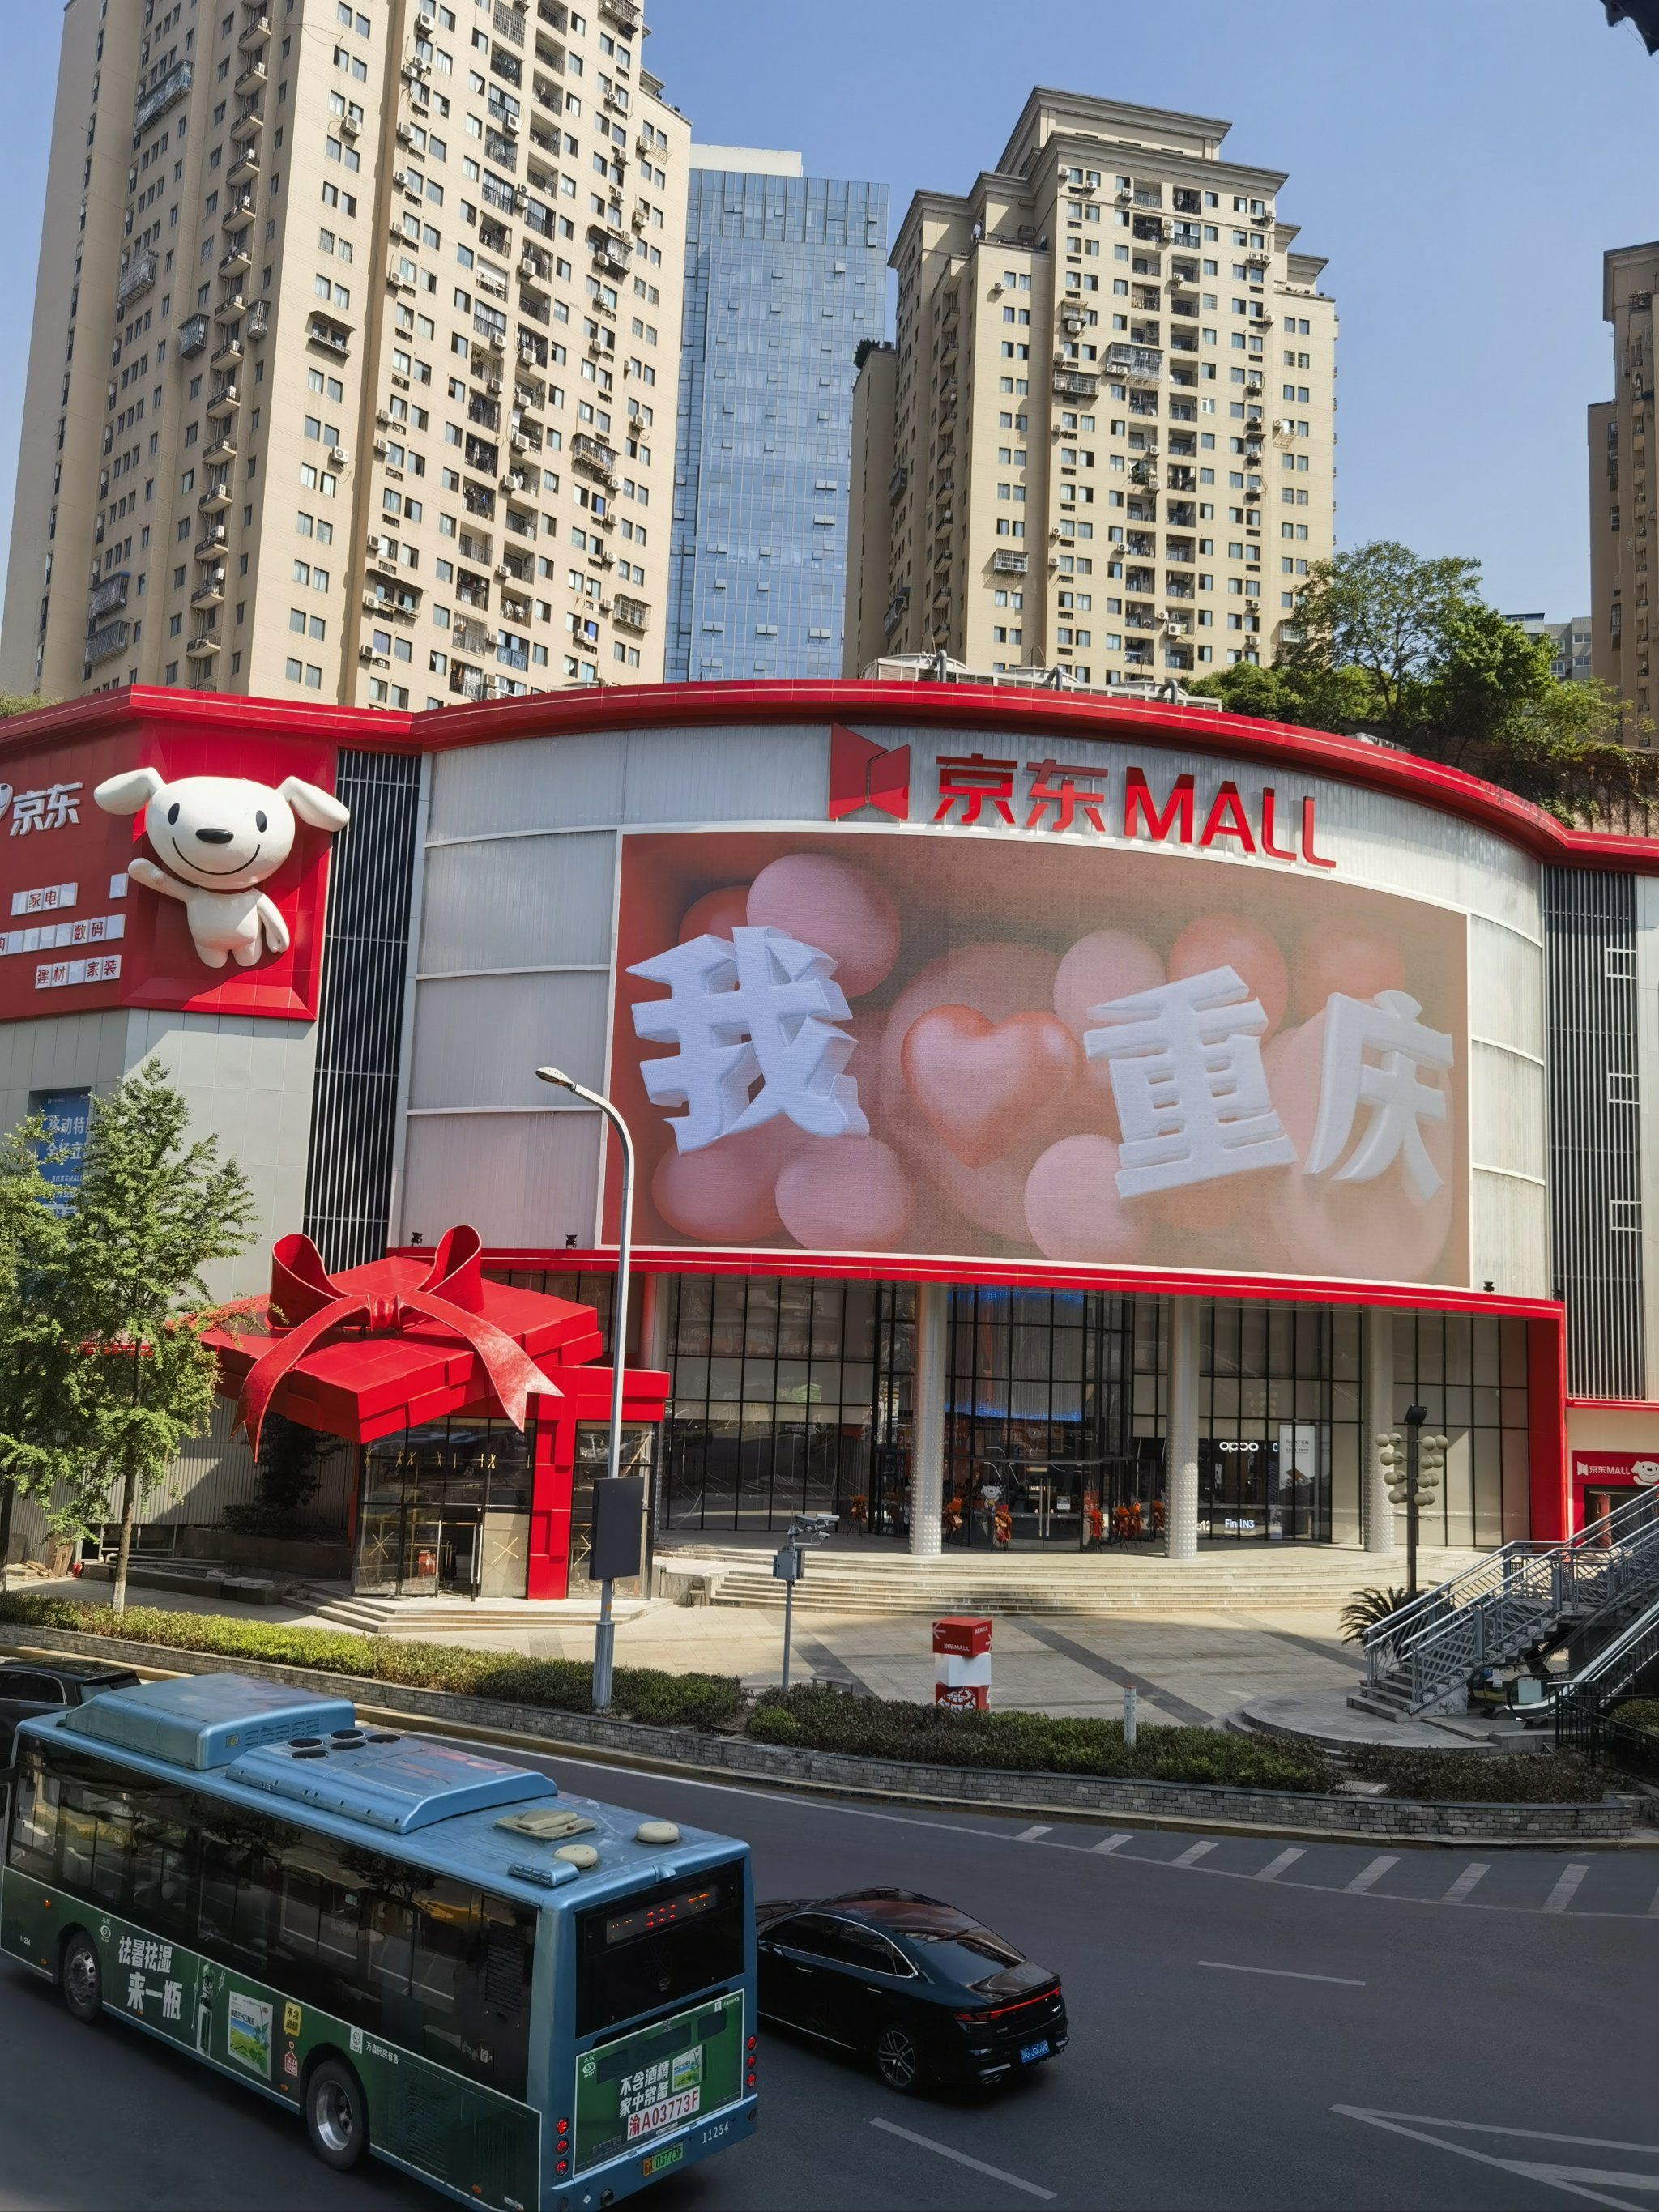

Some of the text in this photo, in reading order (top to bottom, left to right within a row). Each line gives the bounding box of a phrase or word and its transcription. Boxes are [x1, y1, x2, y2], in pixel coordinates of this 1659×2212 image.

[10, 782, 83, 837] 京东
[933, 752, 1337, 869] 京东MALL
[28, 889, 58, 910] 家电
[73, 920, 104, 942] 数码
[36, 959, 117, 986] 建材 家装
[625, 925, 1453, 1200] 我 重庆
[49, 1116, 89, 1135] 移动特
[118, 1935, 173, 1974] 祛暑祛湿
[126, 1971, 183, 2020] 来一瓶
[620, 2060, 670, 2097] 不含酒精
[620, 2080, 669, 2118] 家中常备
[629, 2089, 699, 2137] 渝A03773F
[702, 2121, 729, 2144] 11254
